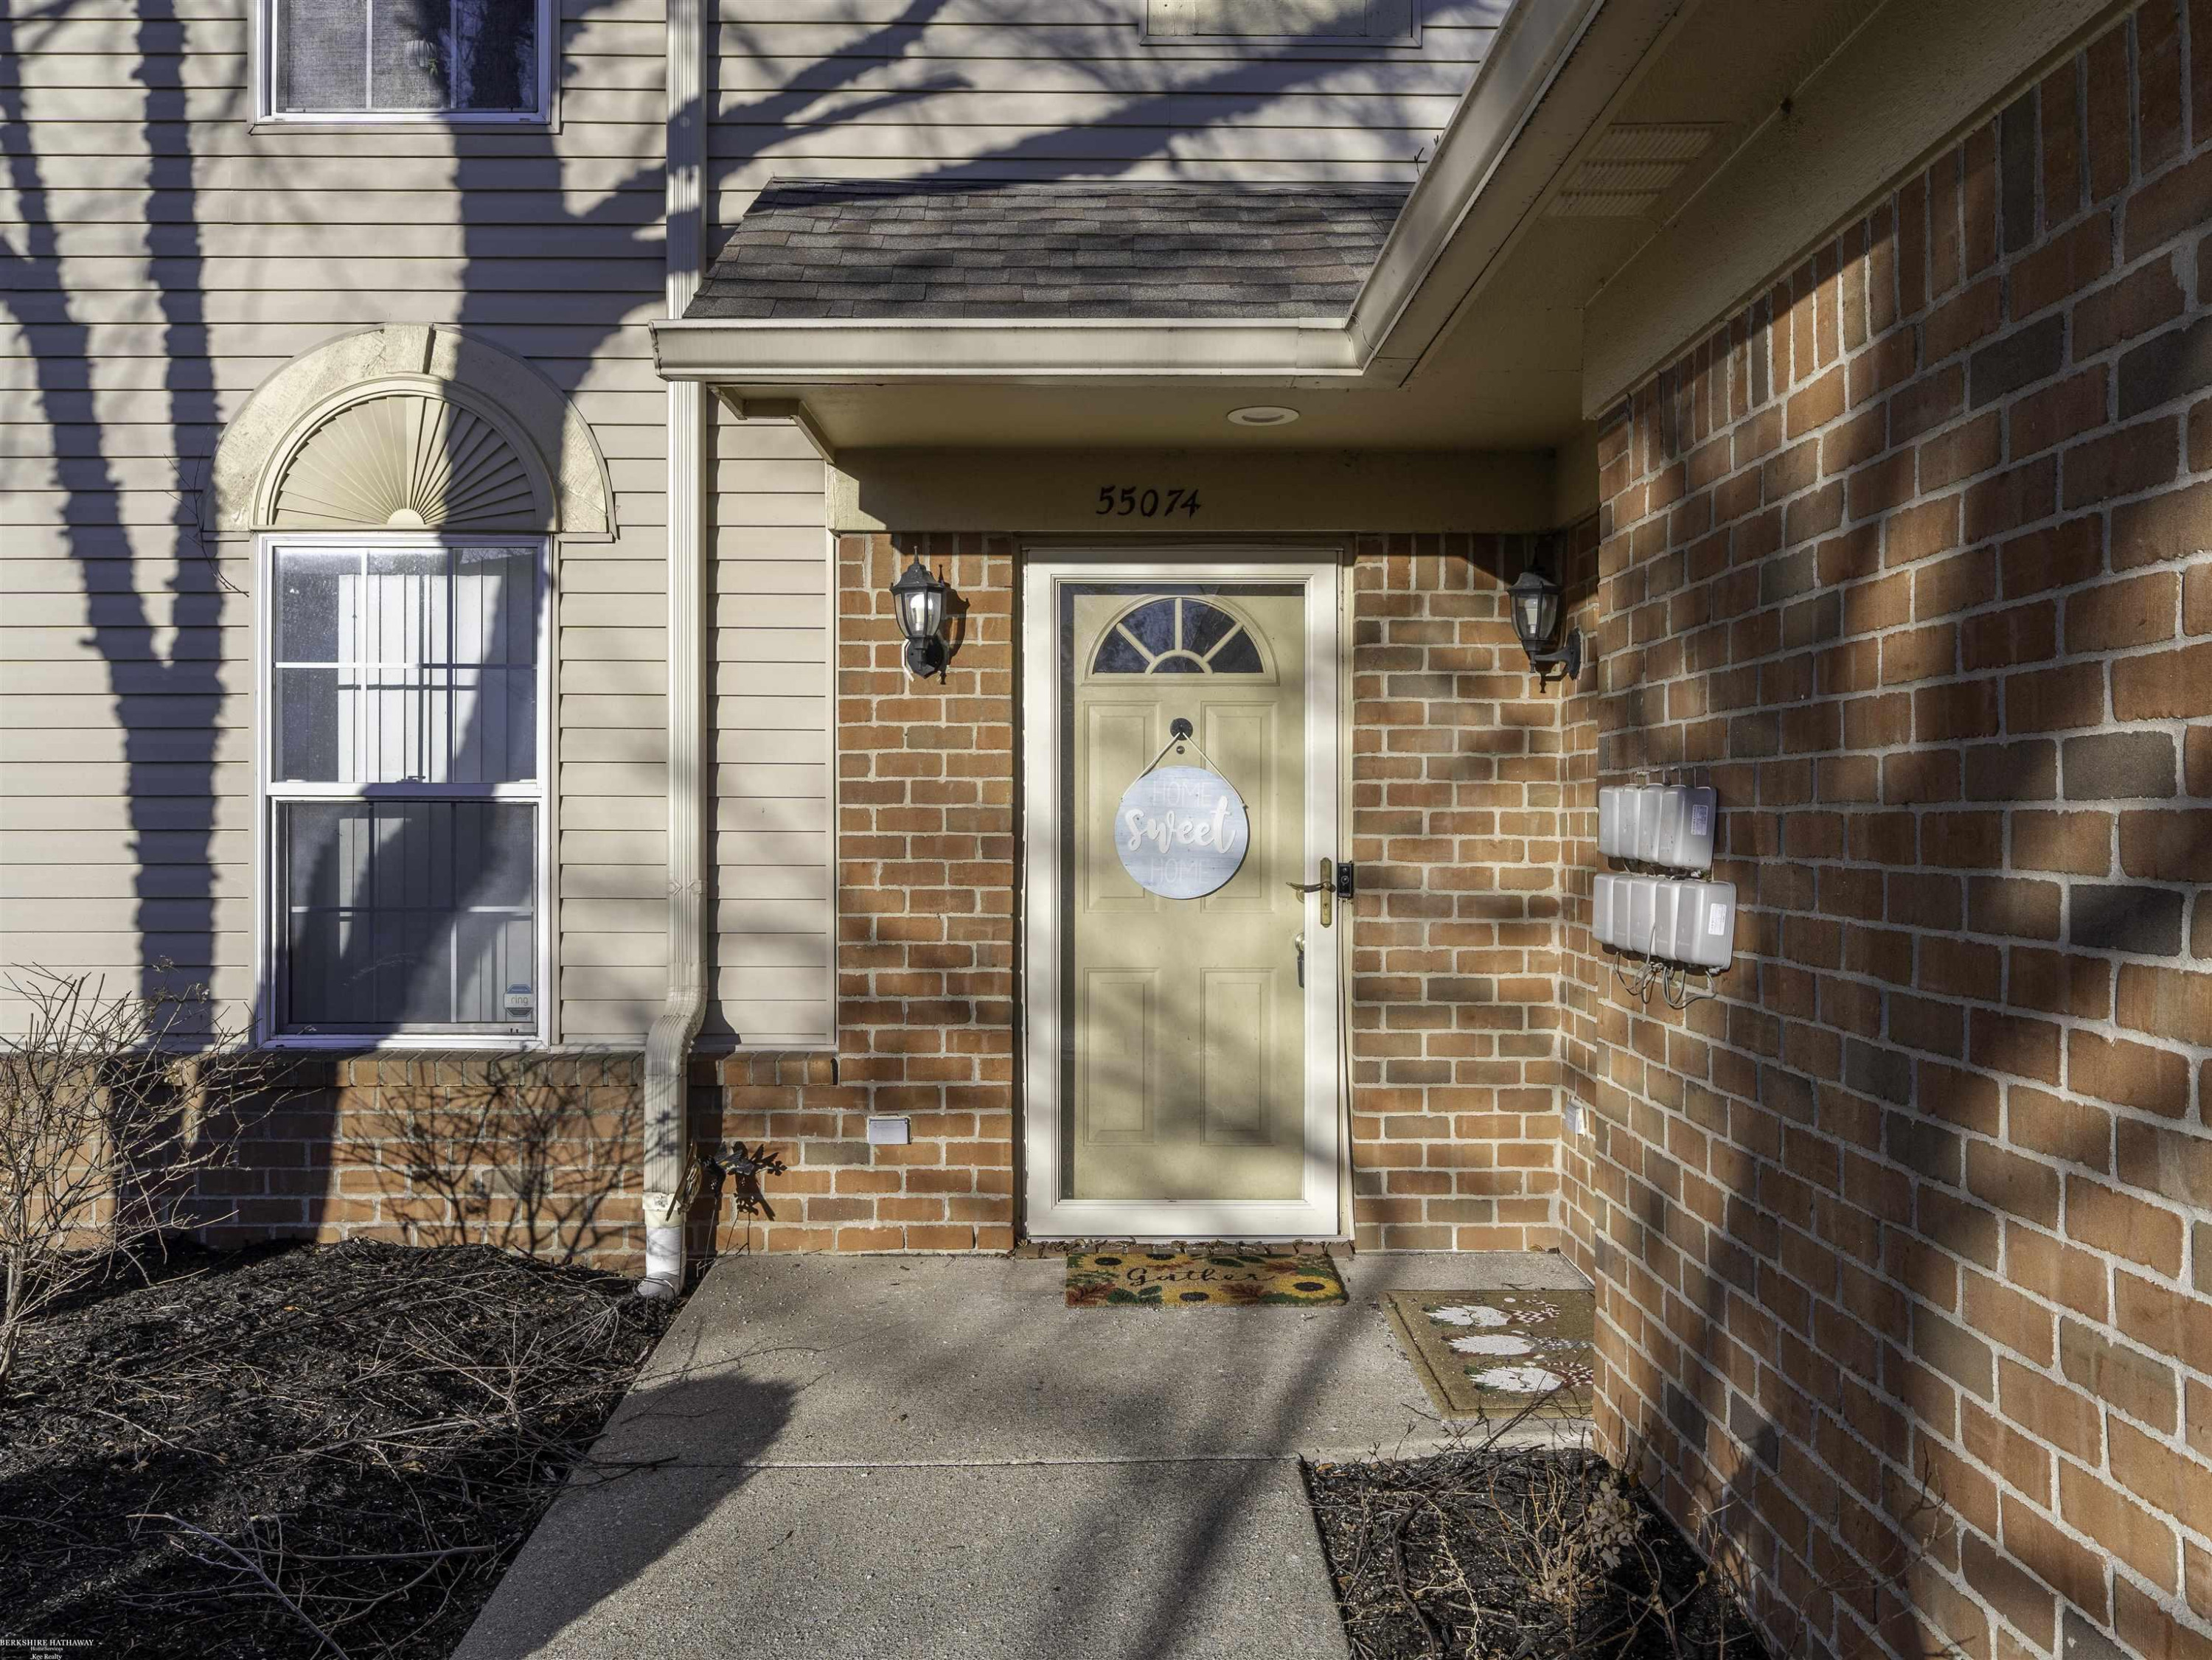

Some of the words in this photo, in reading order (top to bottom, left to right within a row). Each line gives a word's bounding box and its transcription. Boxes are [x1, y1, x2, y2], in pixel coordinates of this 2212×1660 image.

[1096, 485, 1202, 519] 55074
[1152, 779, 1212, 808] HOME
[1150, 857, 1209, 885] HOME
[511, 995, 529, 1006] ring
[1127, 1267, 1276, 1286] Gather
